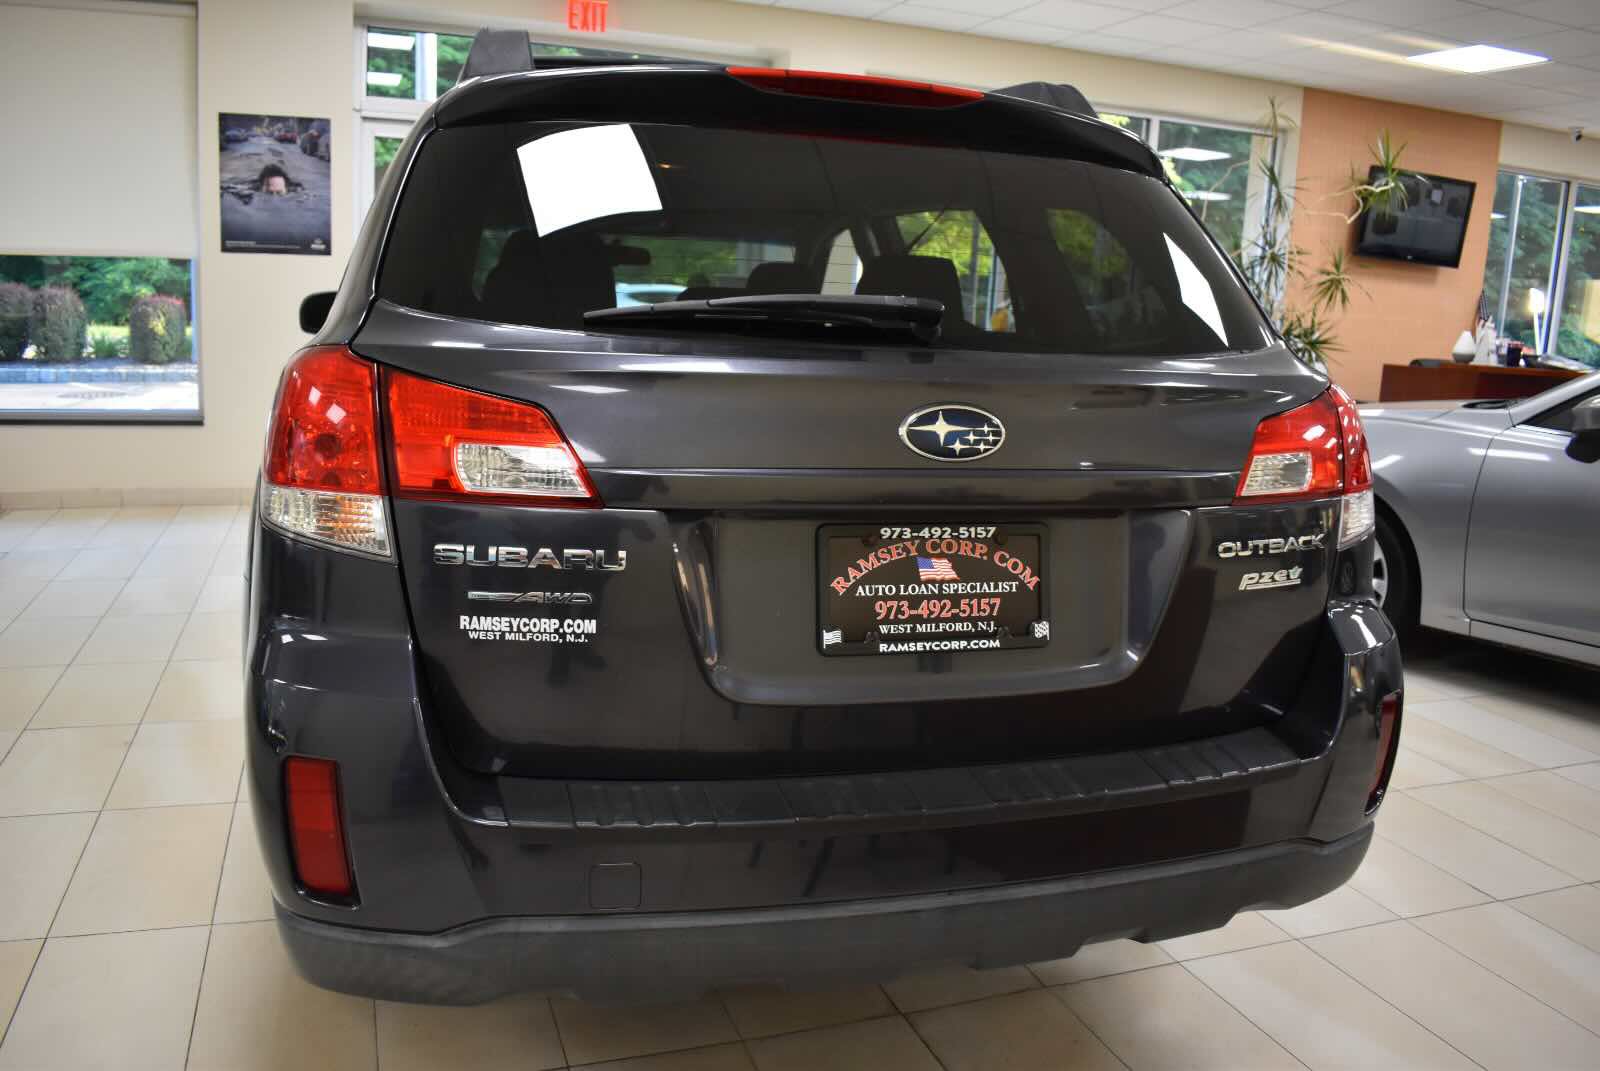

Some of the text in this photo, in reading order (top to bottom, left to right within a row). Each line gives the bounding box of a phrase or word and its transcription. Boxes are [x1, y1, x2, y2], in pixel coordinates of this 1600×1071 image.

[567, 0, 608, 32] EXIT
[880, 526, 997, 539] 973-492-5157
[1218, 533, 1325, 558] OUTBACK
[433, 544, 627, 571] SUBARU
[831, 538, 1040, 596] RAMSEY CORP. COM
[513, 591, 593, 604] AWD
[856, 581, 1019, 597] AUTO LOAN SPECIALIST
[874, 598, 1001, 620] 973-492-5157
[459, 615, 597, 633] RAMSEYCORP.COM
[879, 621, 997, 635] WEST MILFORD, N.J.
[468, 630, 588, 643] WEST MILFORD, N.J.
[879, 640, 1000, 653] RAMSEYCORP.COM
